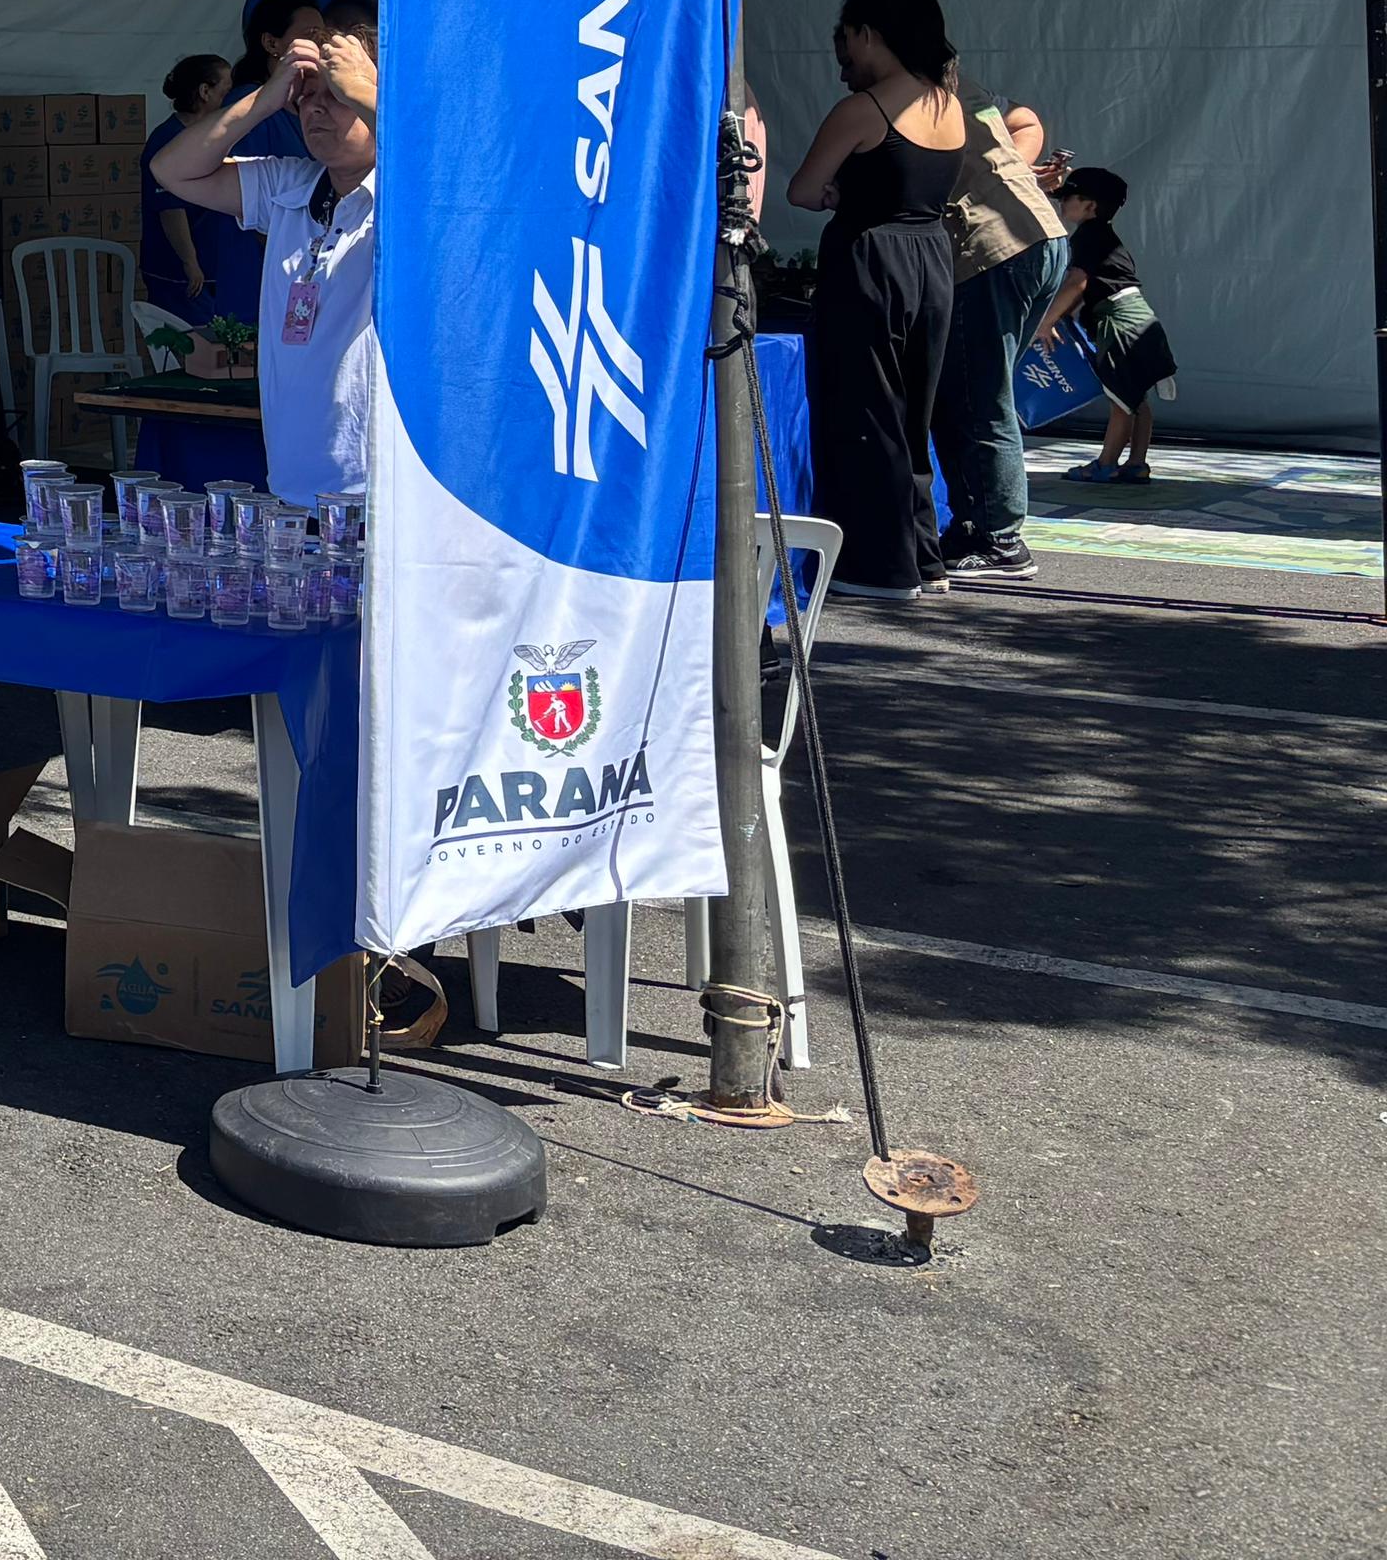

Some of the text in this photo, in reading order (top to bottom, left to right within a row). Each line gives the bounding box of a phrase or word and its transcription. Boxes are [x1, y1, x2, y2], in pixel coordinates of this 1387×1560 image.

[433, 739, 653, 839] PARANÁ
[425, 839, 542, 866] GOVERNO
[561, 834, 582, 848] DO
